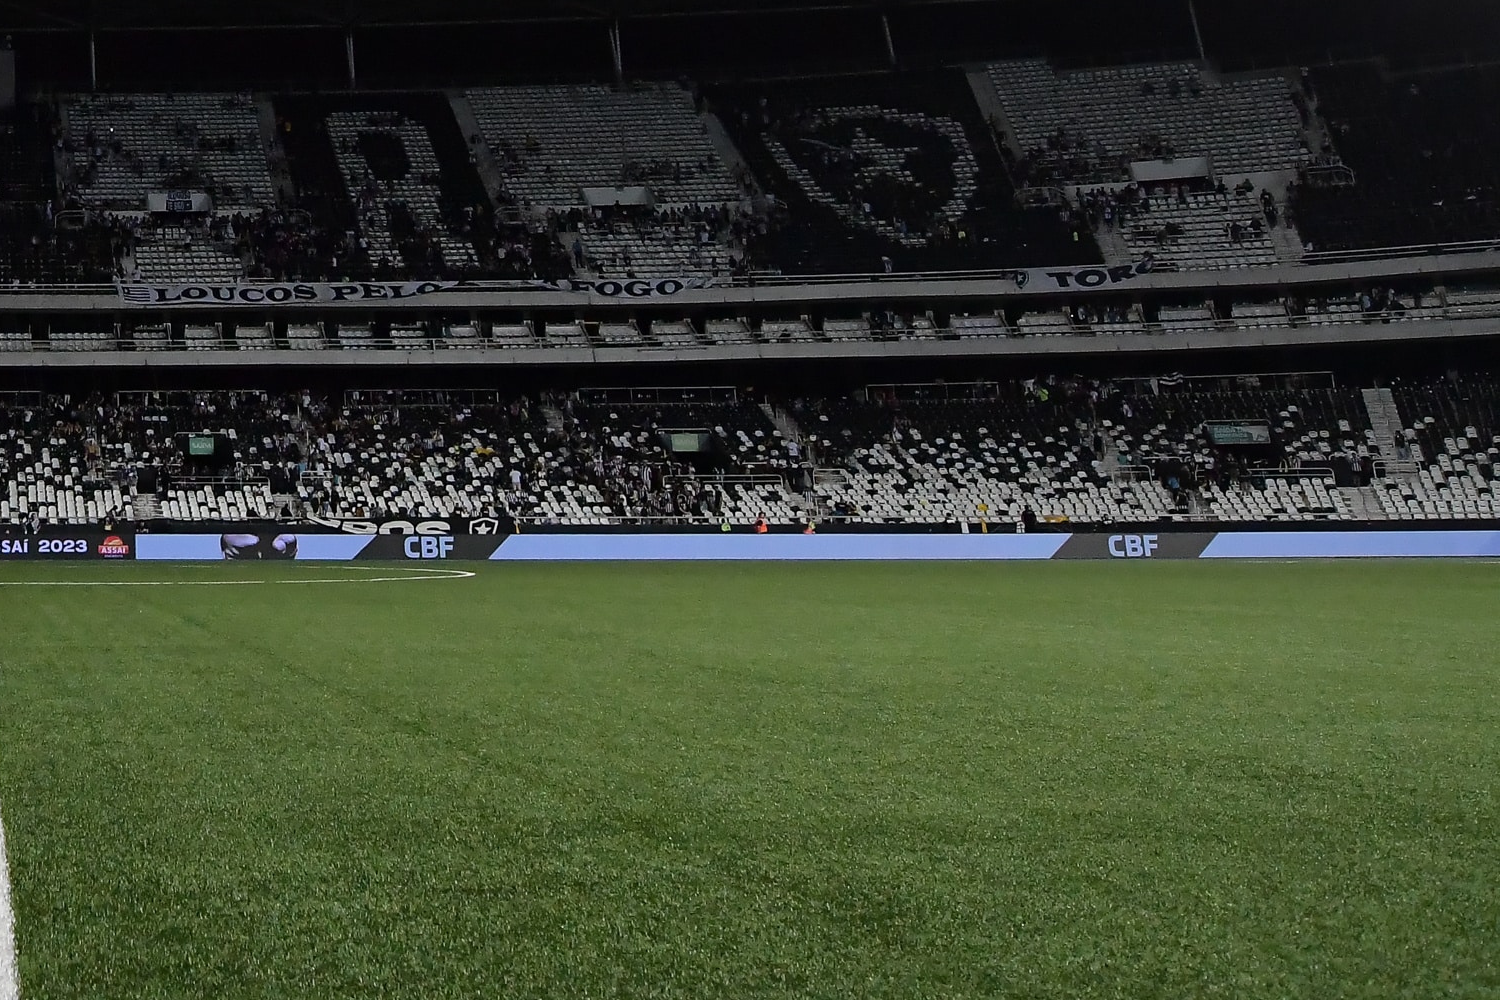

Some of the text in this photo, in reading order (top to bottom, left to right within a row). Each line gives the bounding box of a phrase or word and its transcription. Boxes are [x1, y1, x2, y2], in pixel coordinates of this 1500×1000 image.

[155, 284, 318, 302] LOUCOS
[332, 281, 443, 301] PELO
[38, 539, 88, 554] 2023
[403, 536, 454, 559] CBF
[1108, 534, 1158, 557] CBF
